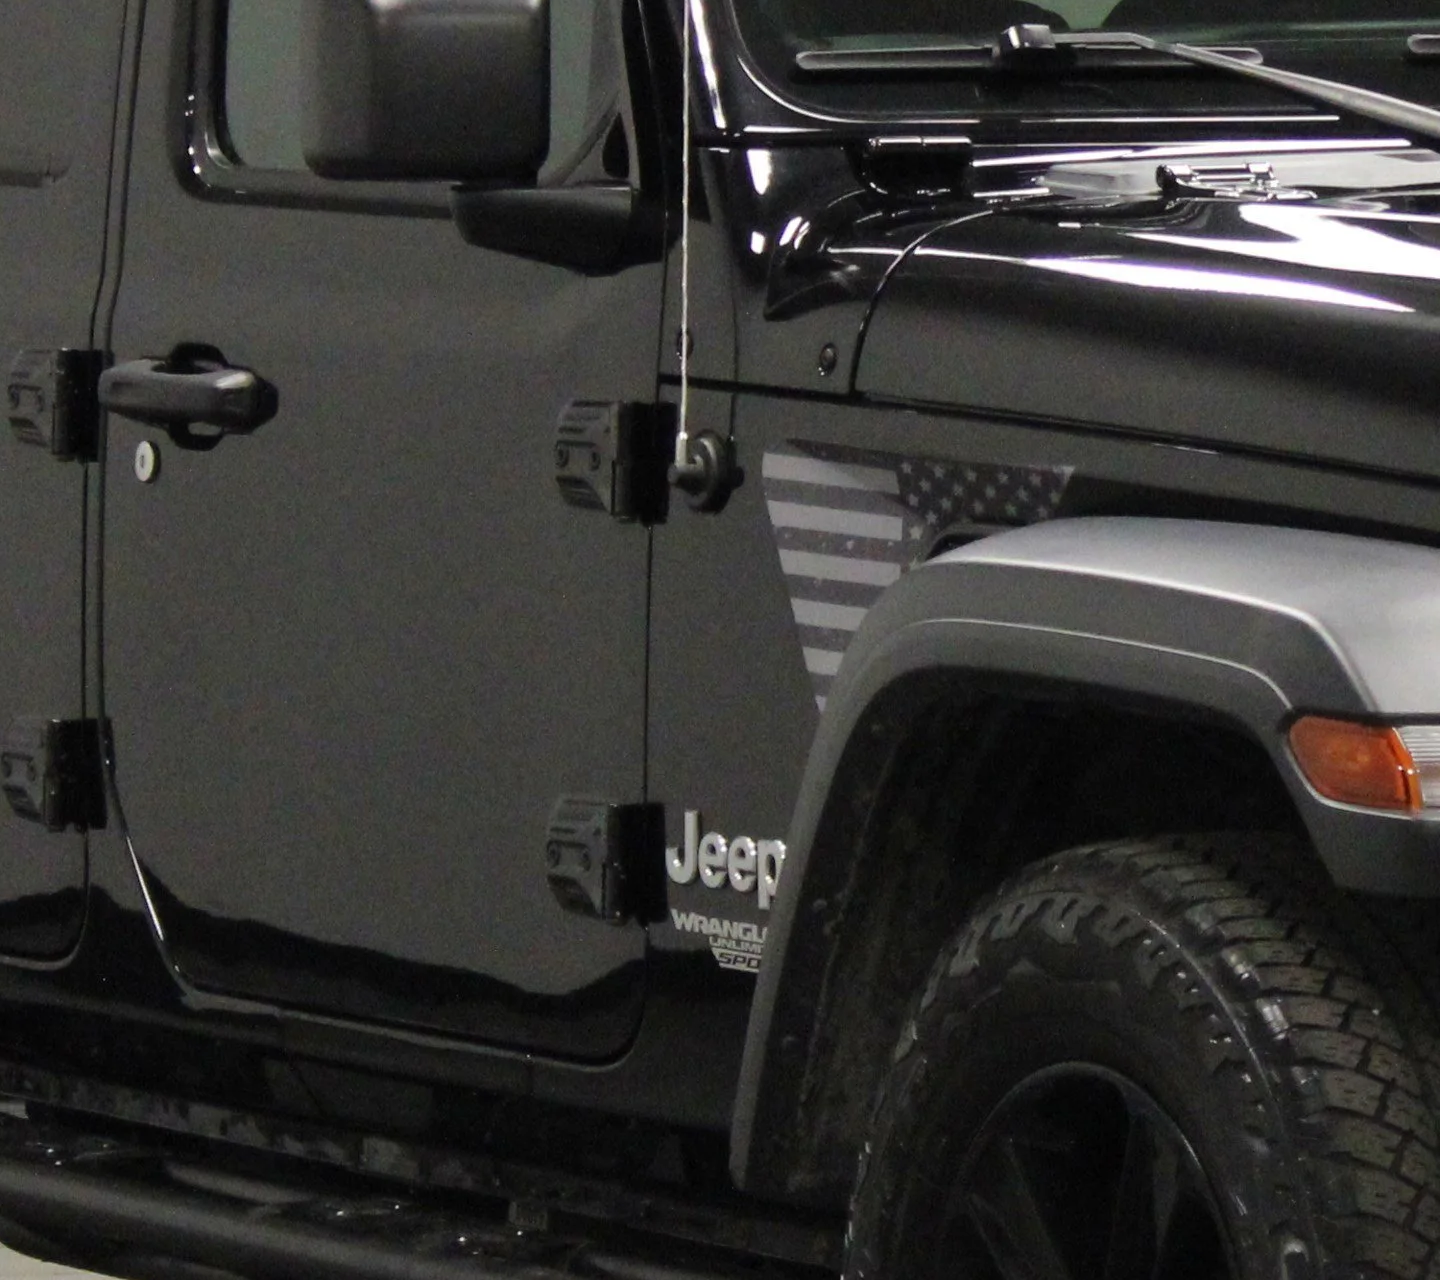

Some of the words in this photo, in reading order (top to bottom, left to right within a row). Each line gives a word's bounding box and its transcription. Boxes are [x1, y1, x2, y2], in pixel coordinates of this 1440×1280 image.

[665, 809, 786, 910] Jeep
[670, 908, 768, 944] WRANGL
[717, 951, 761, 969] SPO
